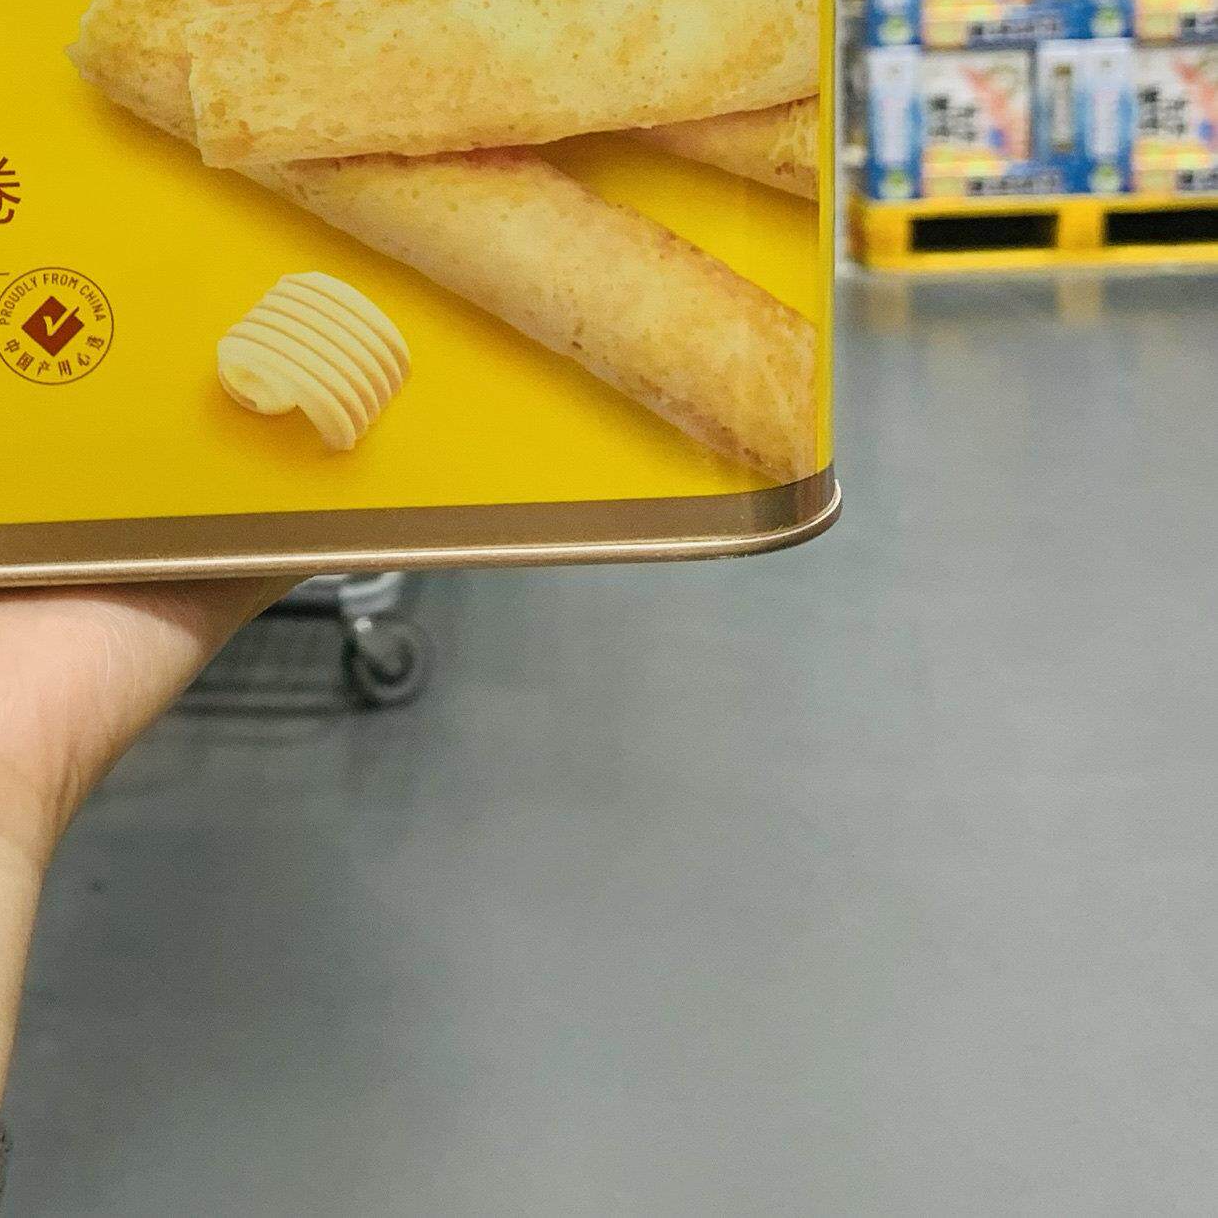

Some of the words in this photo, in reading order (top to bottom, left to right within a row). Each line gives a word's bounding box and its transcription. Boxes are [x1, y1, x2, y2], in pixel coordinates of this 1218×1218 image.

[0, 276, 38, 325] PROUDLY
[43, 273, 79, 289] FROM
[79, 284, 106, 321] CHINA
